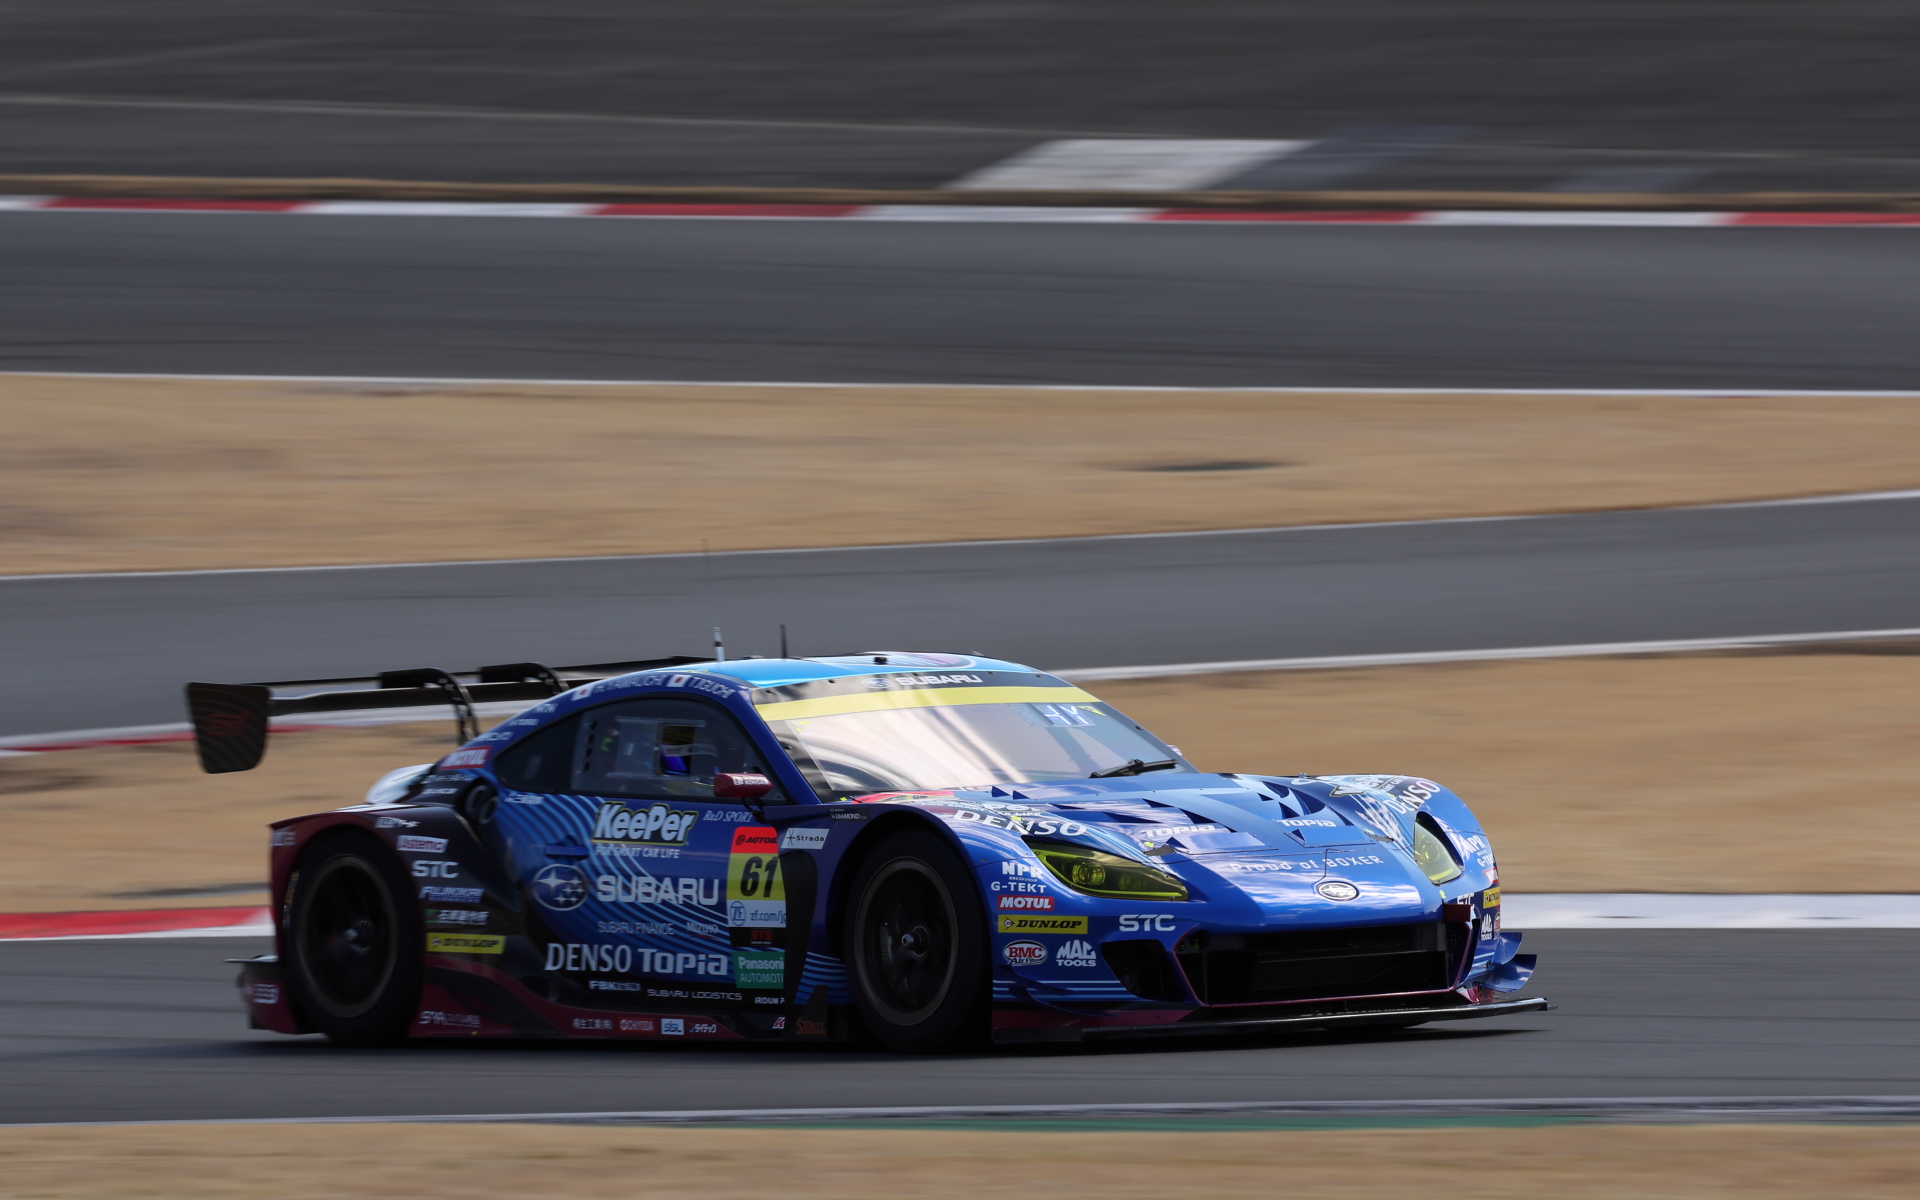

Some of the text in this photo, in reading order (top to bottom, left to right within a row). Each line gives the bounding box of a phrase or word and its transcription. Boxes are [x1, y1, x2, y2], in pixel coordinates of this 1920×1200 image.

[895, 674, 984, 687] SUBARU
[1382, 780, 1441, 815] DENSO
[593, 802, 697, 842] KeePer
[723, 811, 754, 823] SPORT
[952, 810, 1087, 837] DENSO
[796, 835, 825, 843] Strada
[642, 847, 659, 859] CAR
[660, 848, 681, 860] LIFE
[411, 859, 459, 879] STC
[1001, 861, 1045, 879] NPR
[1229, 855, 1385, 873] Proud of BOXER
[740, 856, 779, 898] 61
[597, 874, 719, 906] SUBARU
[990, 881, 1047, 894] G-TEKT
[999, 896, 1052, 909] MOTUL
[731, 906, 745, 921] ZF
[597, 920, 675, 936] SUBARU FINANCE
[686, 921, 719, 934] MIZUHO
[1016, 919, 1083, 929] DUNLOP
[1119, 914, 1176, 932] STC
[1481, 933, 1493, 942] TOOLS
[1008, 946, 1043, 958] BMC
[1056, 939, 1096, 960] MAC
[544, 942, 632, 973] DENSO
[1056, 960, 1097, 968] TOOLS
[647, 988, 743, 1001] SUBARU LOGISTICS
[754, 996, 778, 1005] IRIDIUM
